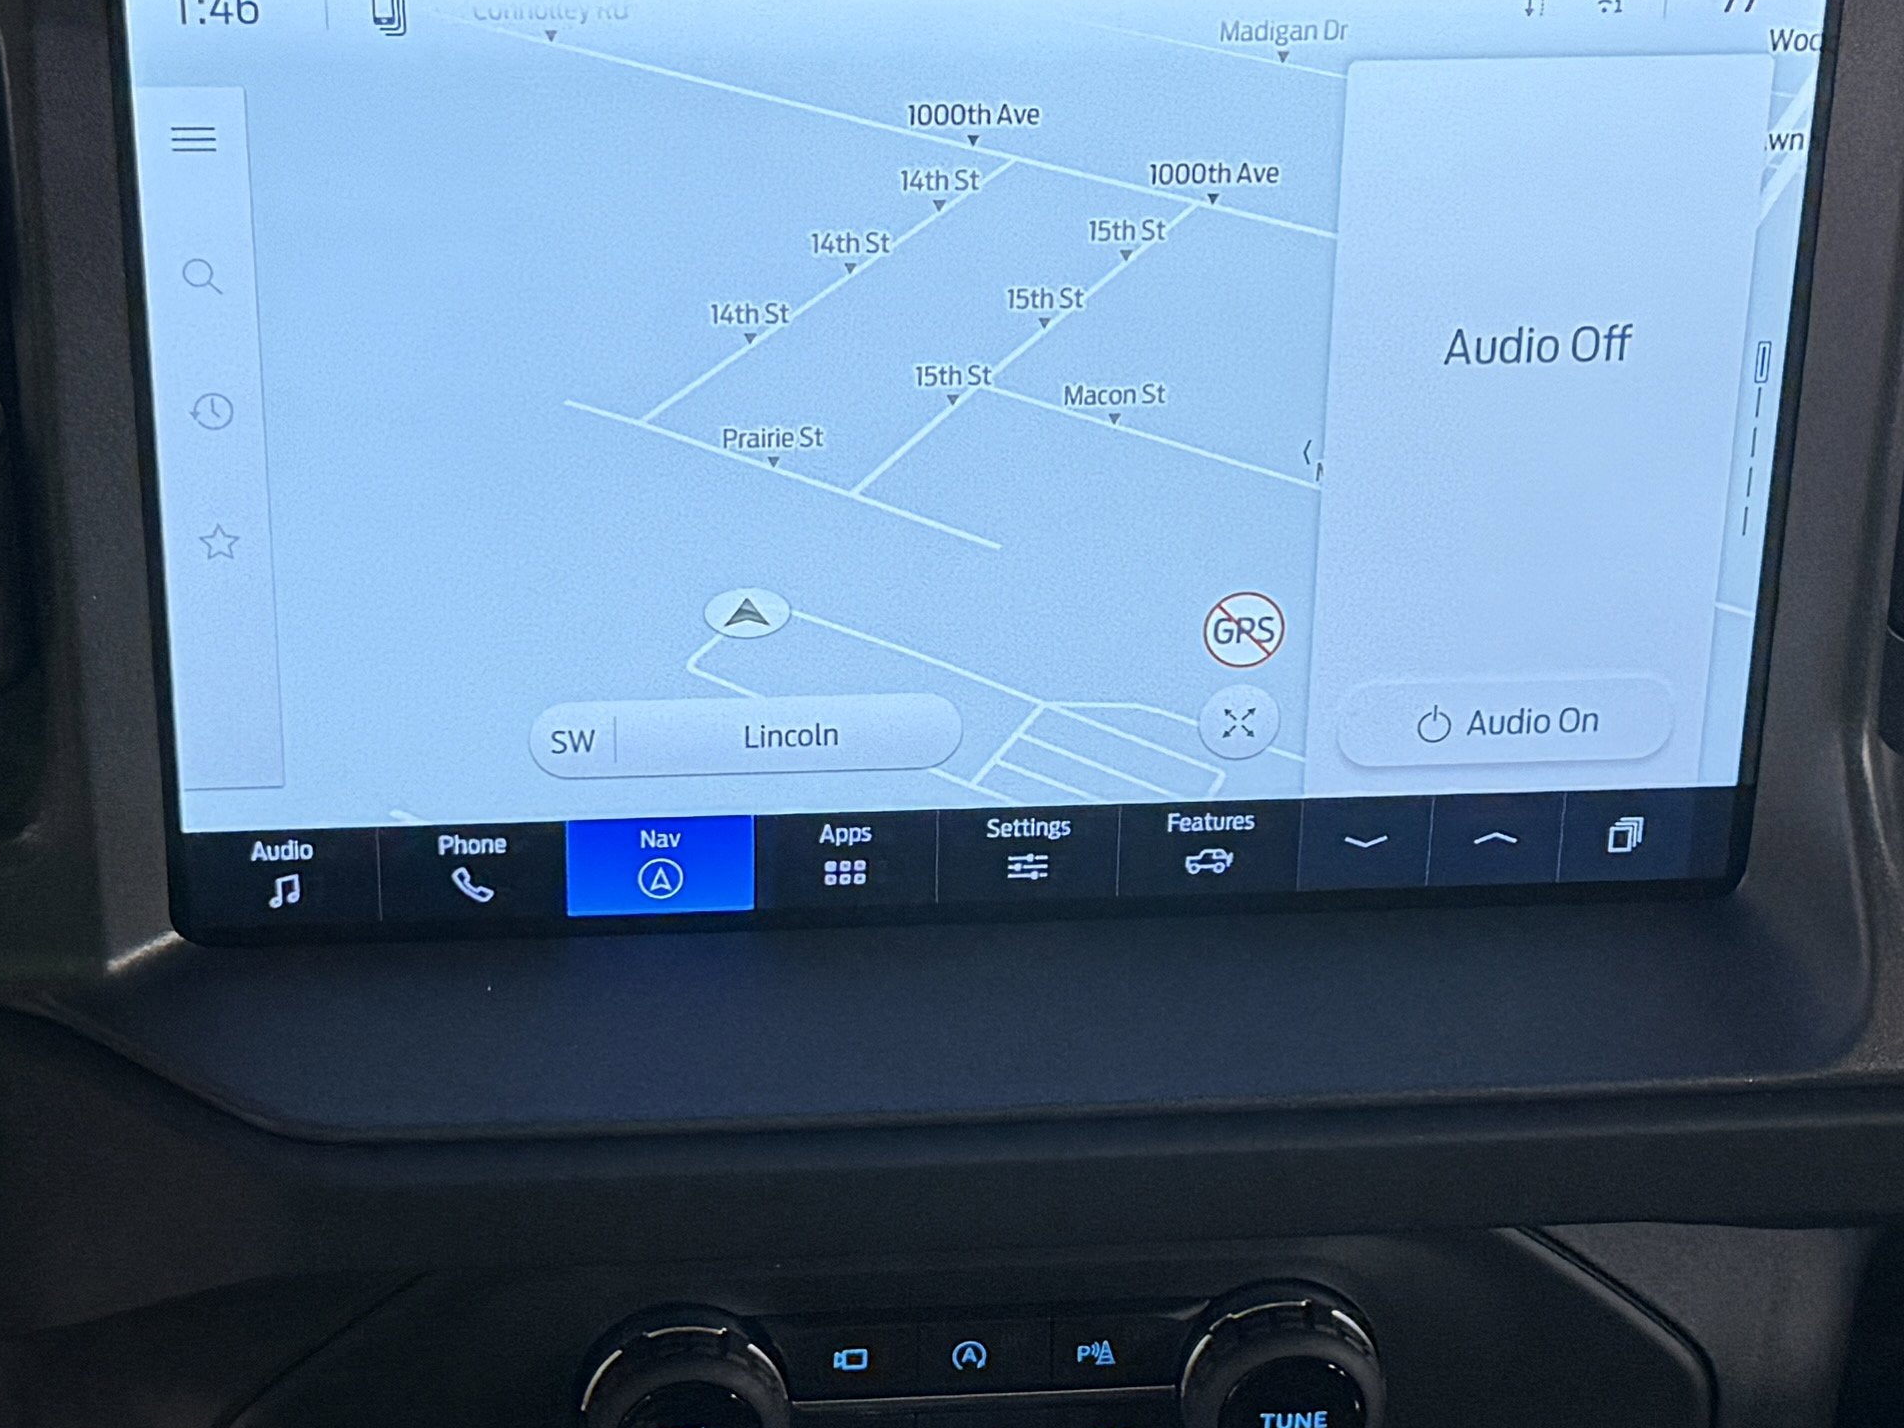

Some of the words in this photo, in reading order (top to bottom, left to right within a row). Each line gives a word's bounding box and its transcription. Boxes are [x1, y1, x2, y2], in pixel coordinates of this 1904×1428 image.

[1219, 18, 1313, 46] Madigan
[1317, 17, 1349, 41] Dr
[907, 102, 992, 128] 1000th
[996, 104, 1041, 128] Ave
[899, 169, 953, 193] 14th
[956, 169, 980, 193] St
[1148, 161, 1233, 186] 1000th
[1237, 162, 1280, 185] Ave
[810, 232, 864, 256] 14th
[867, 231, 891, 256] St
[1088, 219, 1140, 243] 15th
[1143, 219, 1167, 242] St
[1006, 287, 1058, 311] 15th
[1061, 286, 1085, 310] St
[710, 302, 763, 326] 14th
[766, 302, 790, 326] St
[1443, 326, 1562, 367] Audio
[1571, 324, 1634, 364] Off
[914, 364, 967, 388] 15th
[970, 364, 993, 388] St
[1063, 384, 1137, 408] Macon
[1142, 383, 1167, 406] St
[722, 426, 794, 451] Prairie
[799, 427, 825, 450] St
[1466, 707, 1553, 737] Audio
[1558, 706, 1600, 735] On
[550, 729, 596, 755] SW
[743, 722, 840, 751] Lincoln
[986, 816, 1072, 844] Settings
[1167, 811, 1256, 835] Features
[437, 834, 508, 857] Phone
[639, 828, 682, 850] Nav
[819, 823, 873, 850] Apps
[250, 839, 314, 862] Audio
